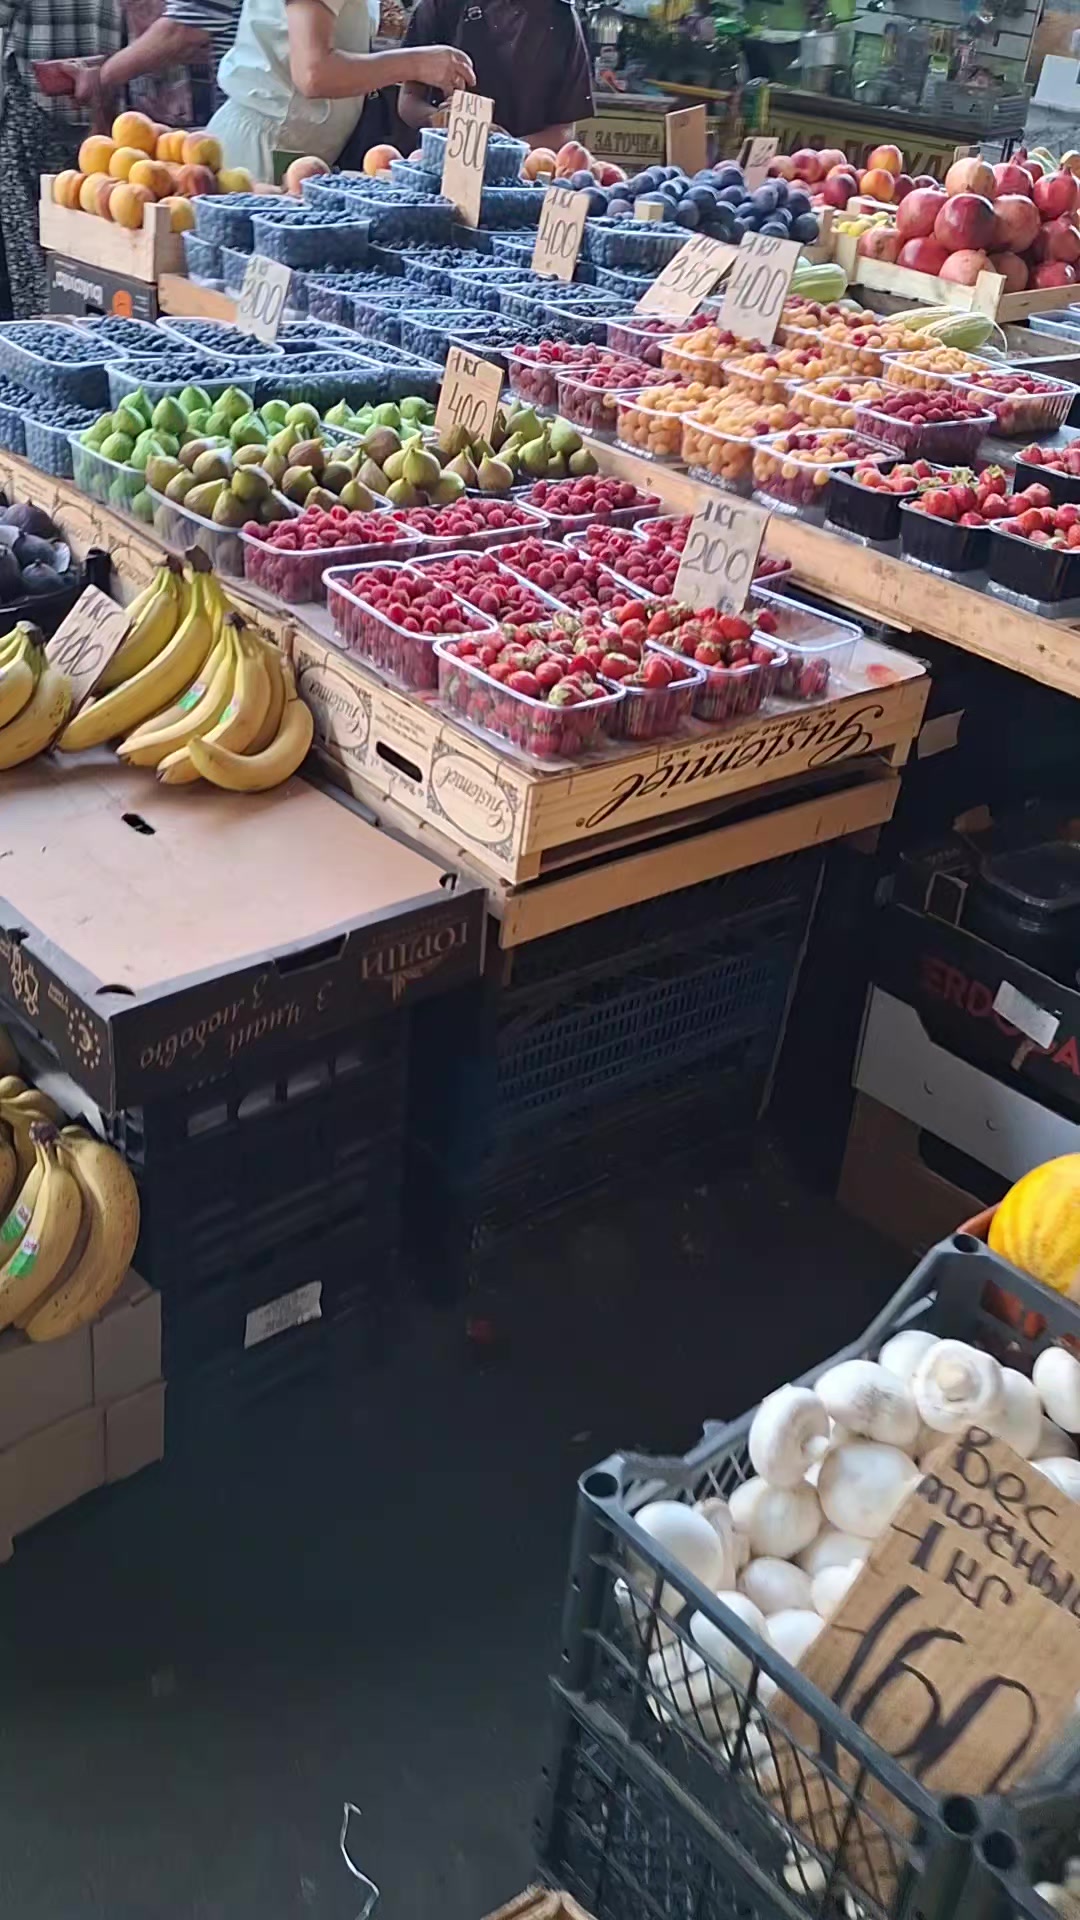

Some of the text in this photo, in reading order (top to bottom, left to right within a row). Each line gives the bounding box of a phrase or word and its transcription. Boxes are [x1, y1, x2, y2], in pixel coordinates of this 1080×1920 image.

[448, 117, 488, 172] 500
[540, 211, 578, 258] 400
[659, 255, 721, 299] 350
[728, 261, 788, 318] 400
[448, 382, 488, 433] 400
[681, 532, 750, 583] 200
[585, 704, 884, 829] Gustemiel
[436, 766, 506, 834] Gustemiel
[819, 1584, 1038, 1796] 160
